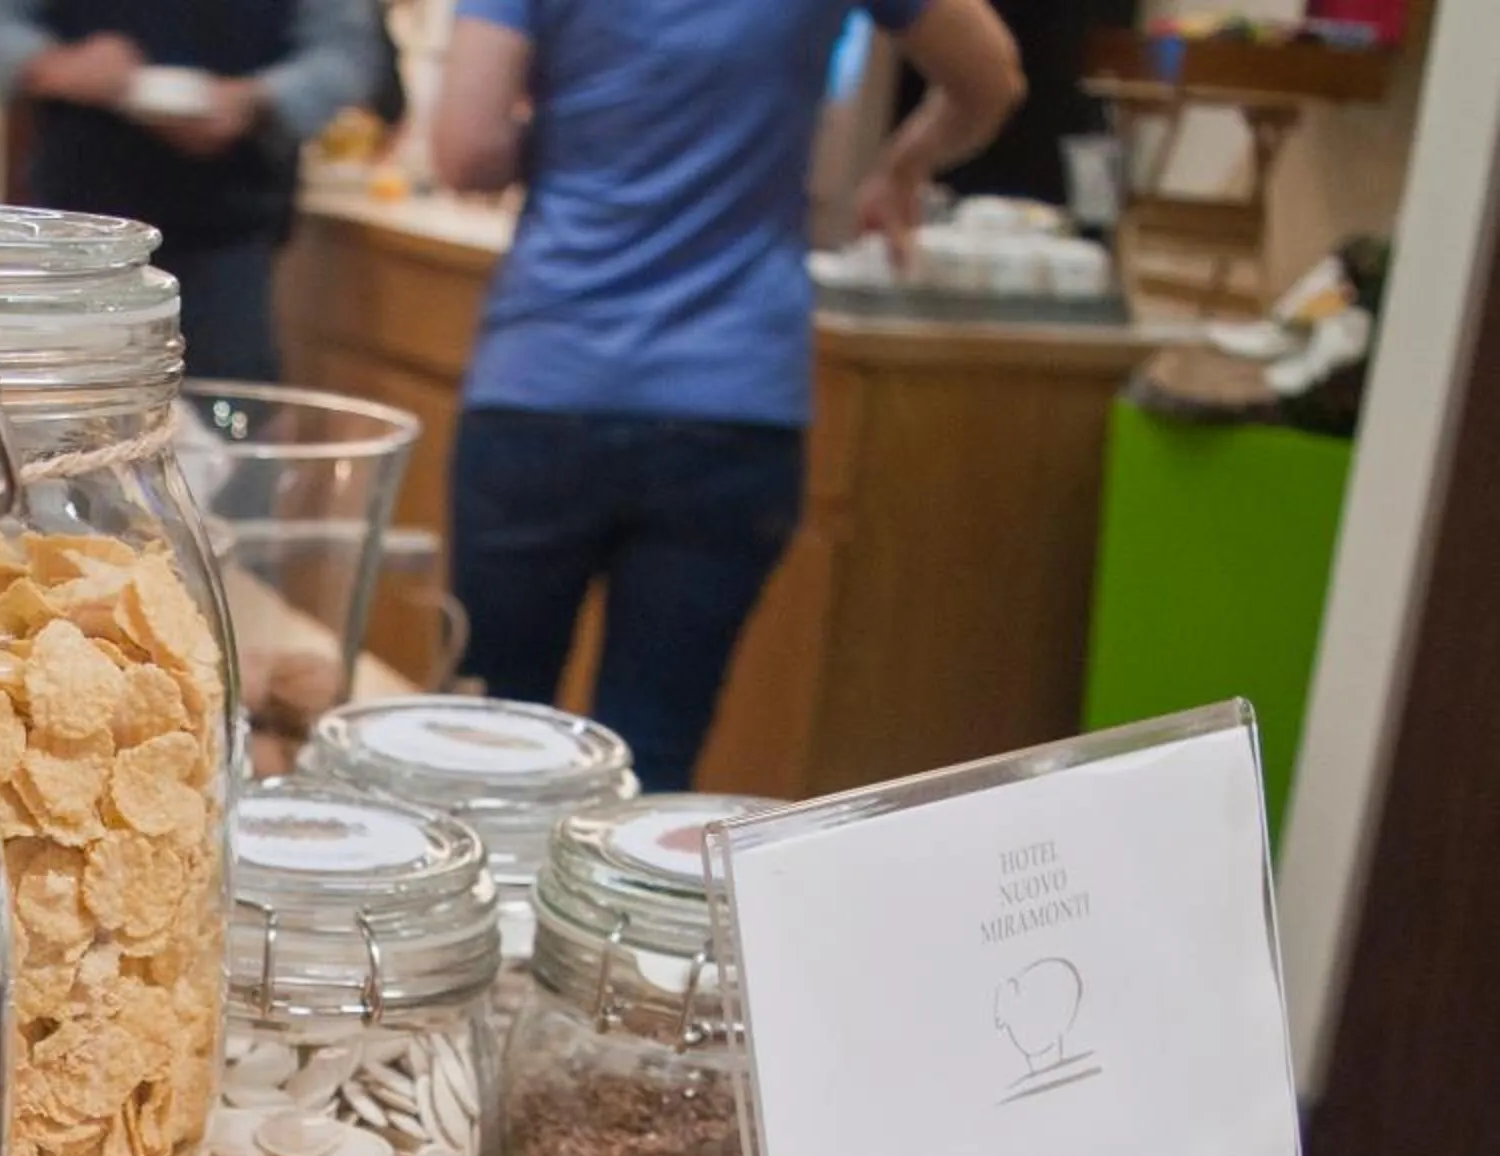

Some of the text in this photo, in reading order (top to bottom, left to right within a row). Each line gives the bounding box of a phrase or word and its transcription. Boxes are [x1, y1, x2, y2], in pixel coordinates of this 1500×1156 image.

[999, 841, 1057, 875] HOTEL
[1000, 867, 1067, 907] NUOVO
[980, 891, 1090, 943] MIRAMONTI
